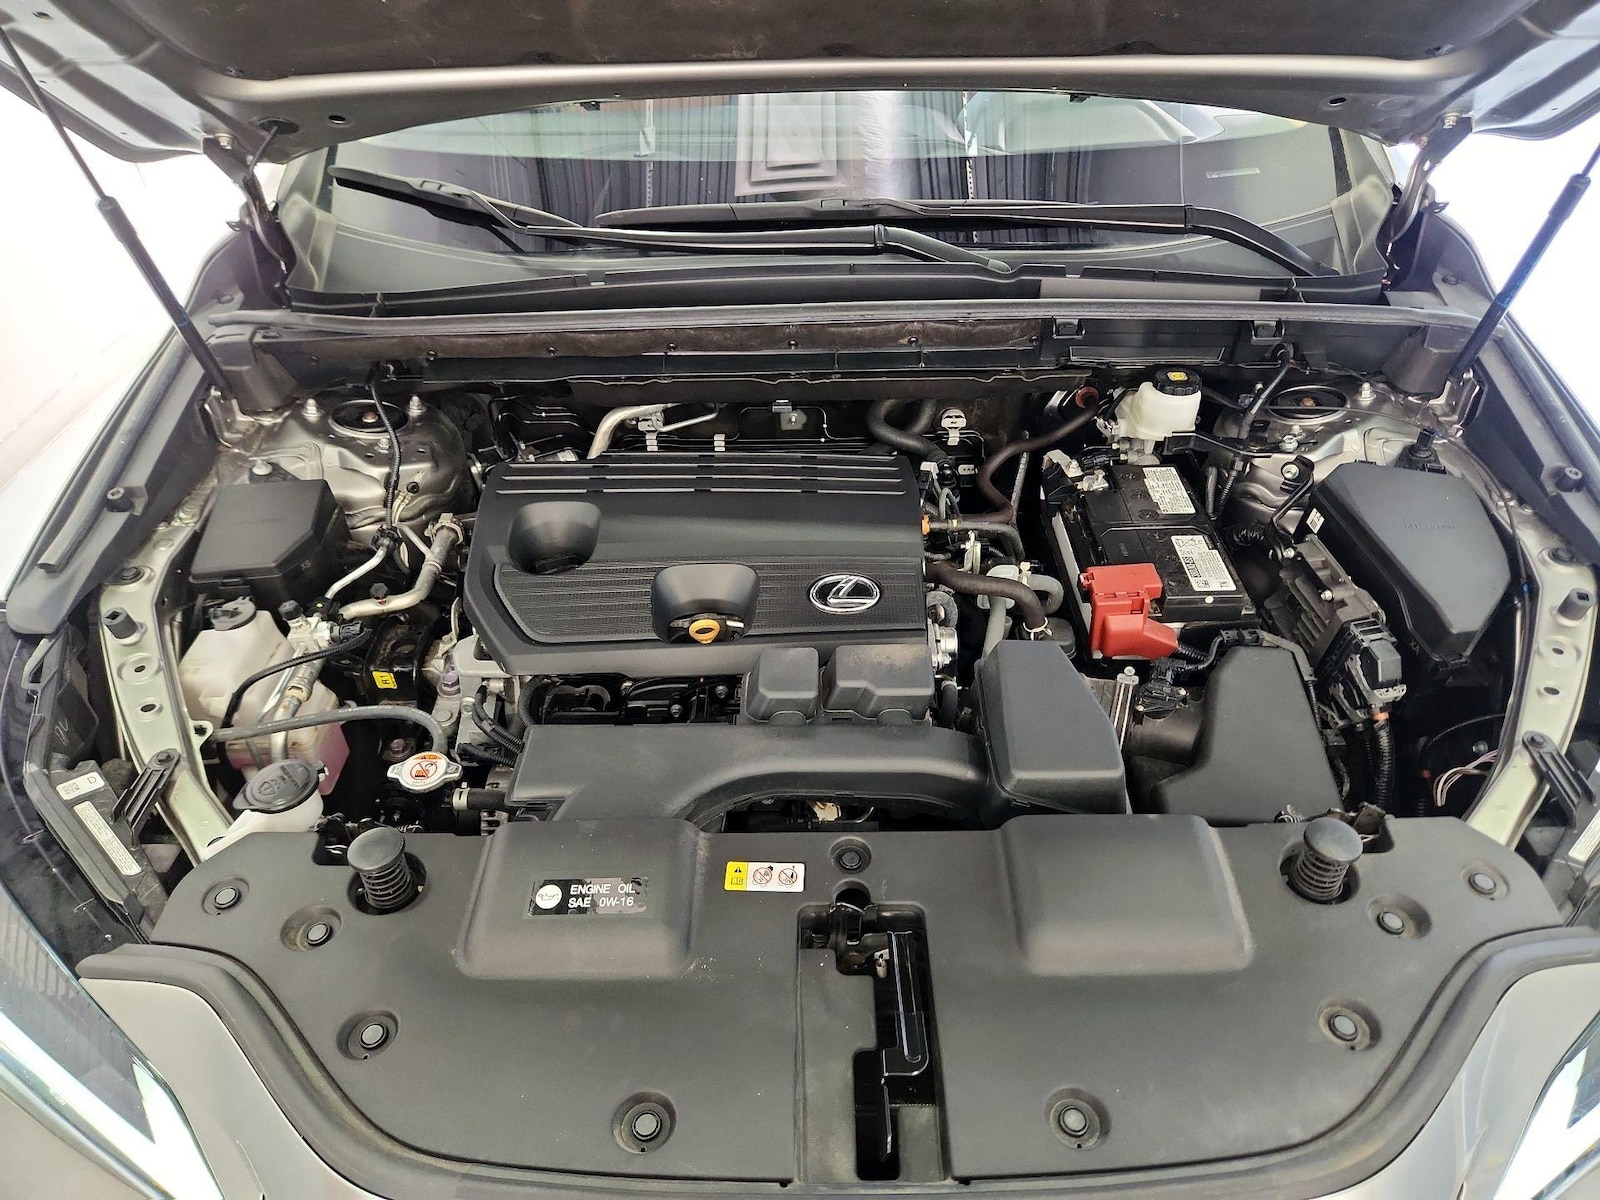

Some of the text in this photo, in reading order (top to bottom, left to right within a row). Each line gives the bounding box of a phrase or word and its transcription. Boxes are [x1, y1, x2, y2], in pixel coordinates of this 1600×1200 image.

[570, 882, 635, 895] ENGINE OIL
[568, 896, 634, 908] SAE 0W-16
